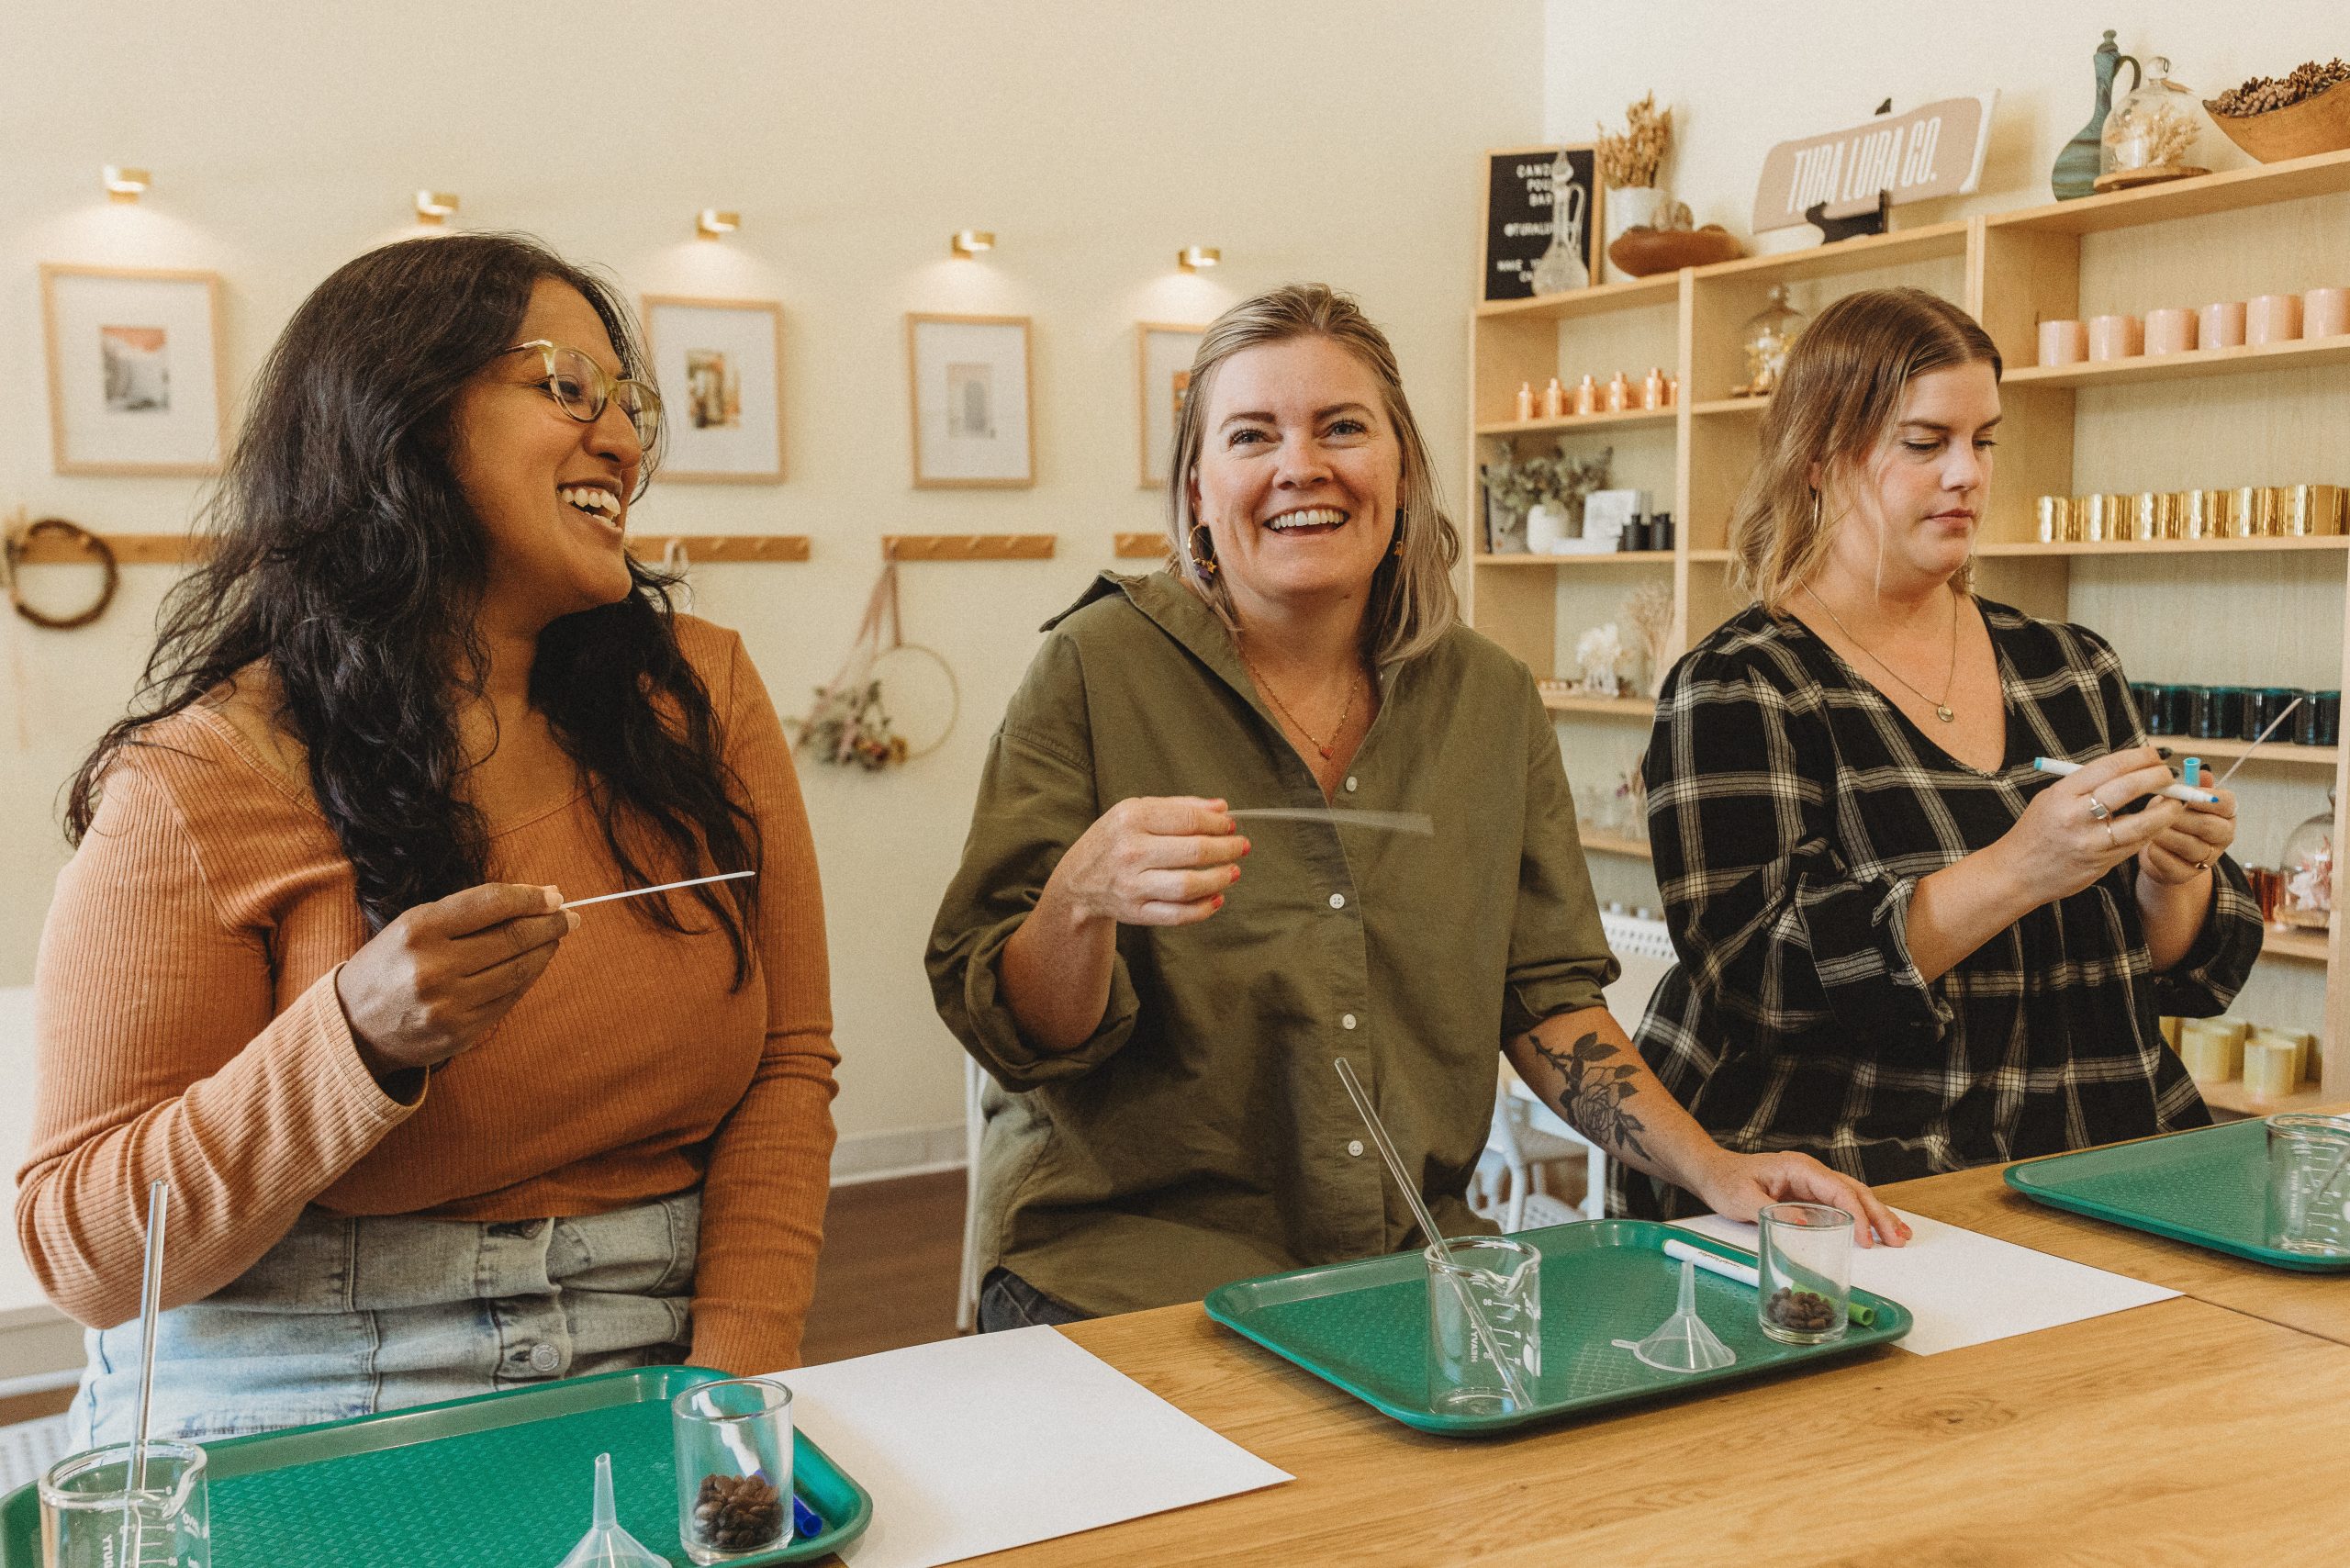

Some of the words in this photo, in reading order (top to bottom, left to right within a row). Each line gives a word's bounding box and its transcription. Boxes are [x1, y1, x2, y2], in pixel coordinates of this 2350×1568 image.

[1516, 163, 1552, 178] CAND
[1787, 141, 1845, 214] TURA
[1841, 126, 1905, 202] LURA
[1900, 116, 1942, 188] CO.
[1527, 178, 1552, 192] POU
